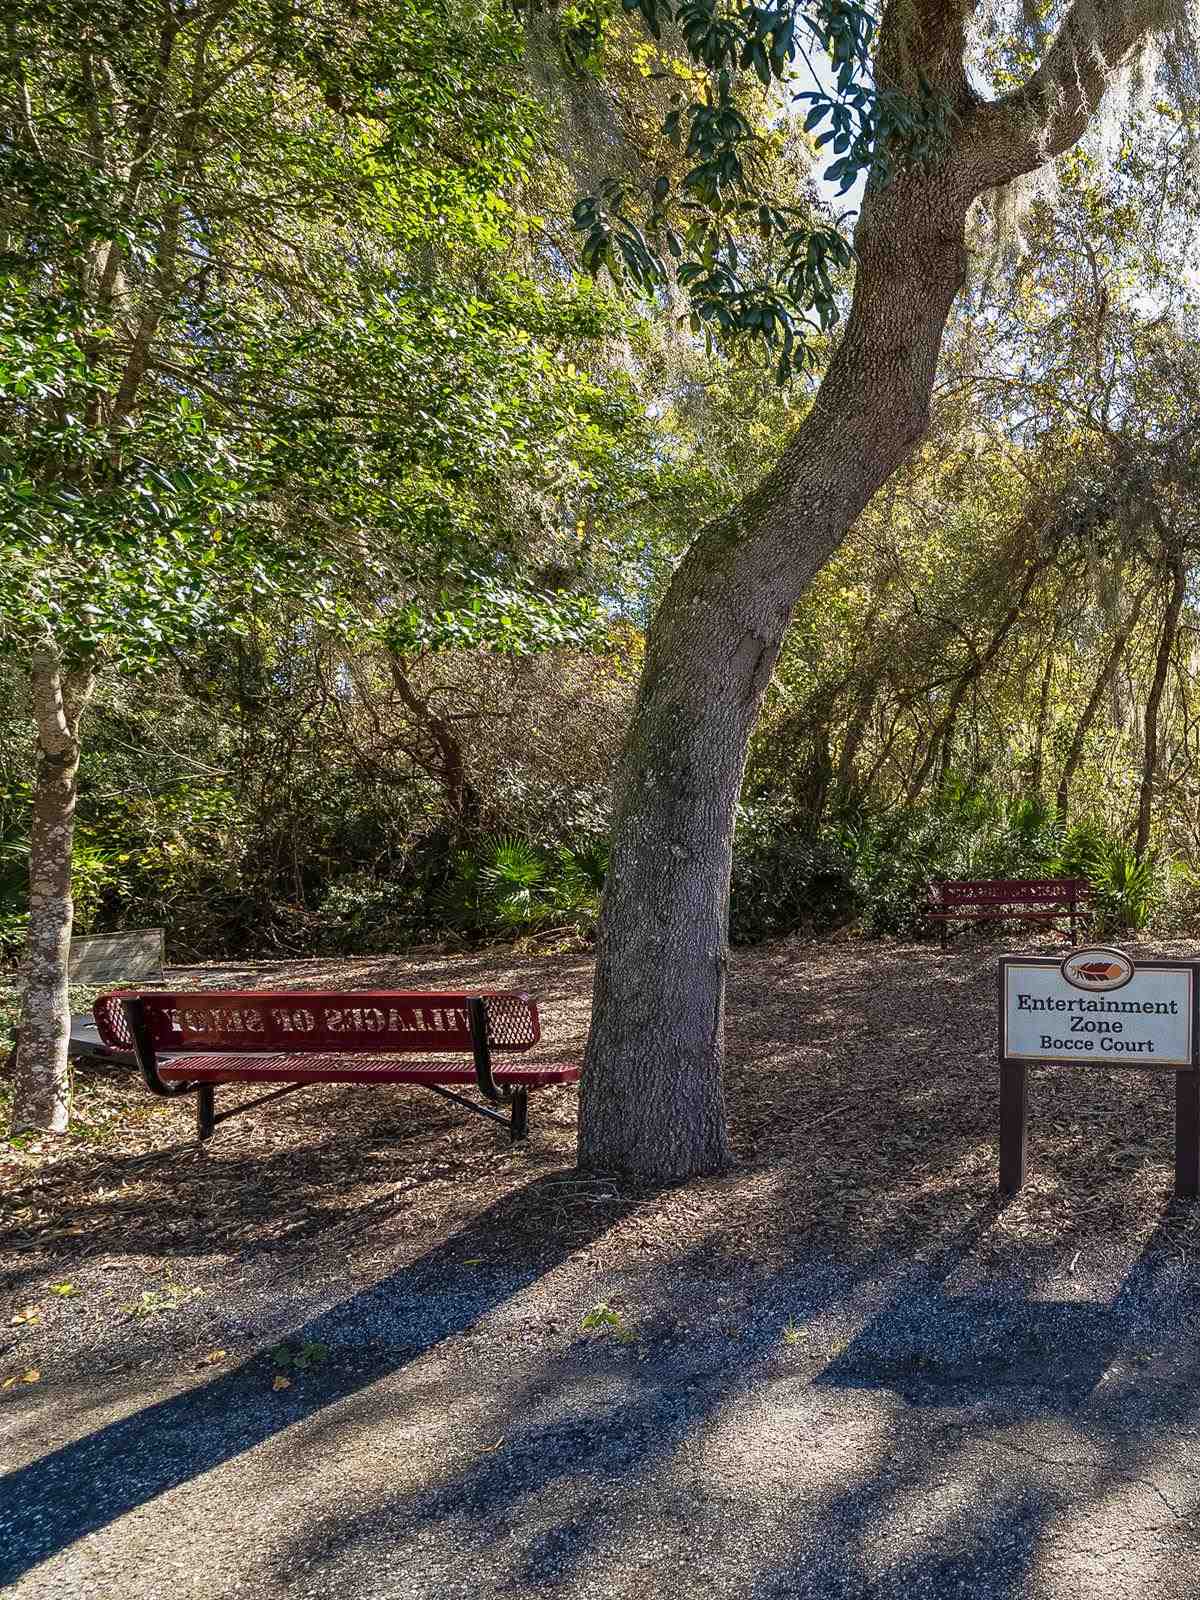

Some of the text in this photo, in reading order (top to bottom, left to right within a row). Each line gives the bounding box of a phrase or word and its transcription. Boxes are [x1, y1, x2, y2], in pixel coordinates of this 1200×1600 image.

[1017, 994, 1178, 1014] Entertainment
[1070, 1016, 1123, 1033] Zone
[1040, 1035, 1155, 1053] Bocce Court
